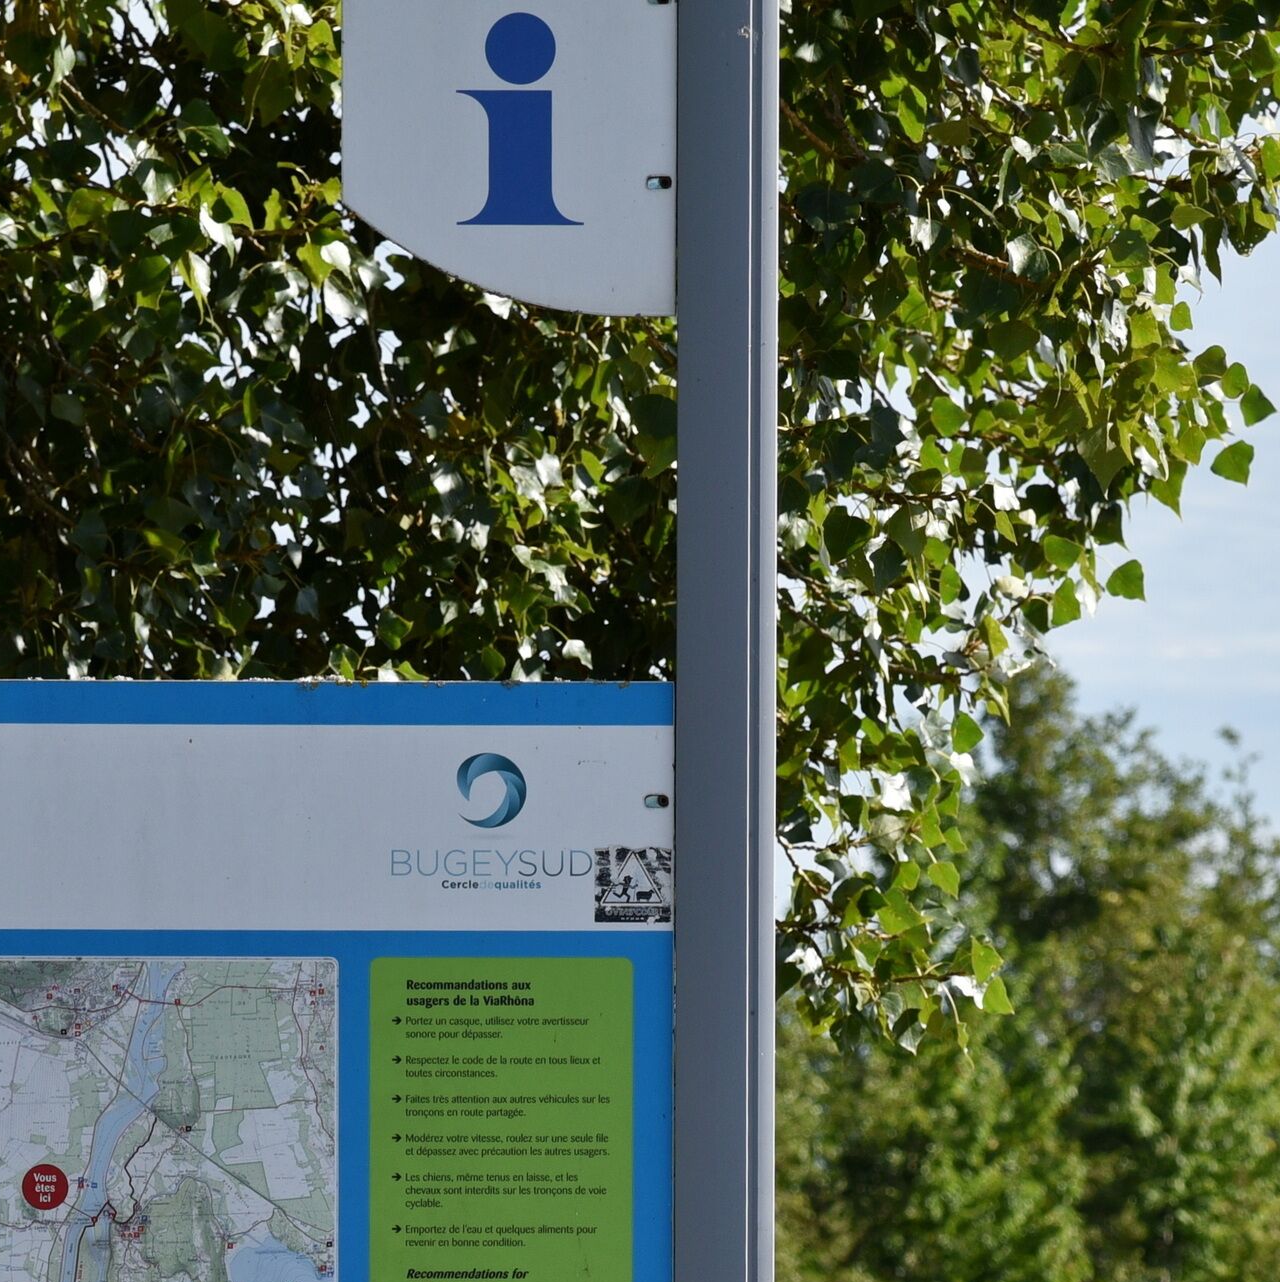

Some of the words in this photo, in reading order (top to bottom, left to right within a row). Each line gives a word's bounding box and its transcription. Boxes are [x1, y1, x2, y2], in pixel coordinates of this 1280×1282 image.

[407, 980, 508, 990] Recommandations
[512, 982, 531, 990] aux
[407, 998, 449, 1009] usagers
[453, 996, 466, 1006] de
[470, 996, 479, 1006] la
[484, 996, 534, 1006] ViaRhôna
[406, 1016, 432, 1025] Portez
[449, 1018, 482, 1028] casque,
[485, 1016, 514, 1025] utilisez
[517, 1017, 539, 1025] votre
[542, 1017, 588, 1025] avertisseur
[439, 1031, 458, 1041] pour
[462, 1029, 502, 1041] dépasser.
[406, 1055, 449, 1067] Respectez
[452, 1055, 459, 1064] le
[462, 1055, 484, 1064] code
[486, 1055, 497, 1064] de
[500, 1055, 507, 1064] la
[510, 1056, 532, 1064] route
[549, 1056, 567, 1064] tous
[570, 1055, 590, 1064] lieux
[592, 1056, 600, 1064] et
[406, 1069, 432, 1077] toutes
[435, 1069, 497, 1077] circonstances.
[405, 1094, 430, 1103] Faites
[433, 1094, 449, 1103] très
[452, 1095, 489, 1103] attention
[510, 1095, 536, 1103] autres
[539, 1094, 579, 1103] véhicules
[598, 1094, 610, 1103] les
[406, 1108, 444, 1119] tronçons
[461, 1108, 483, 1116] route
[486, 1107, 526, 1119] partagée.
[33, 1172, 57, 1182] Vous
[35, 1183, 56, 1192] êtes
[39, 1193, 51, 1203] ici
[406, 1269, 509, 1279] Recommendations
[511, 1269, 529, 1279] for
